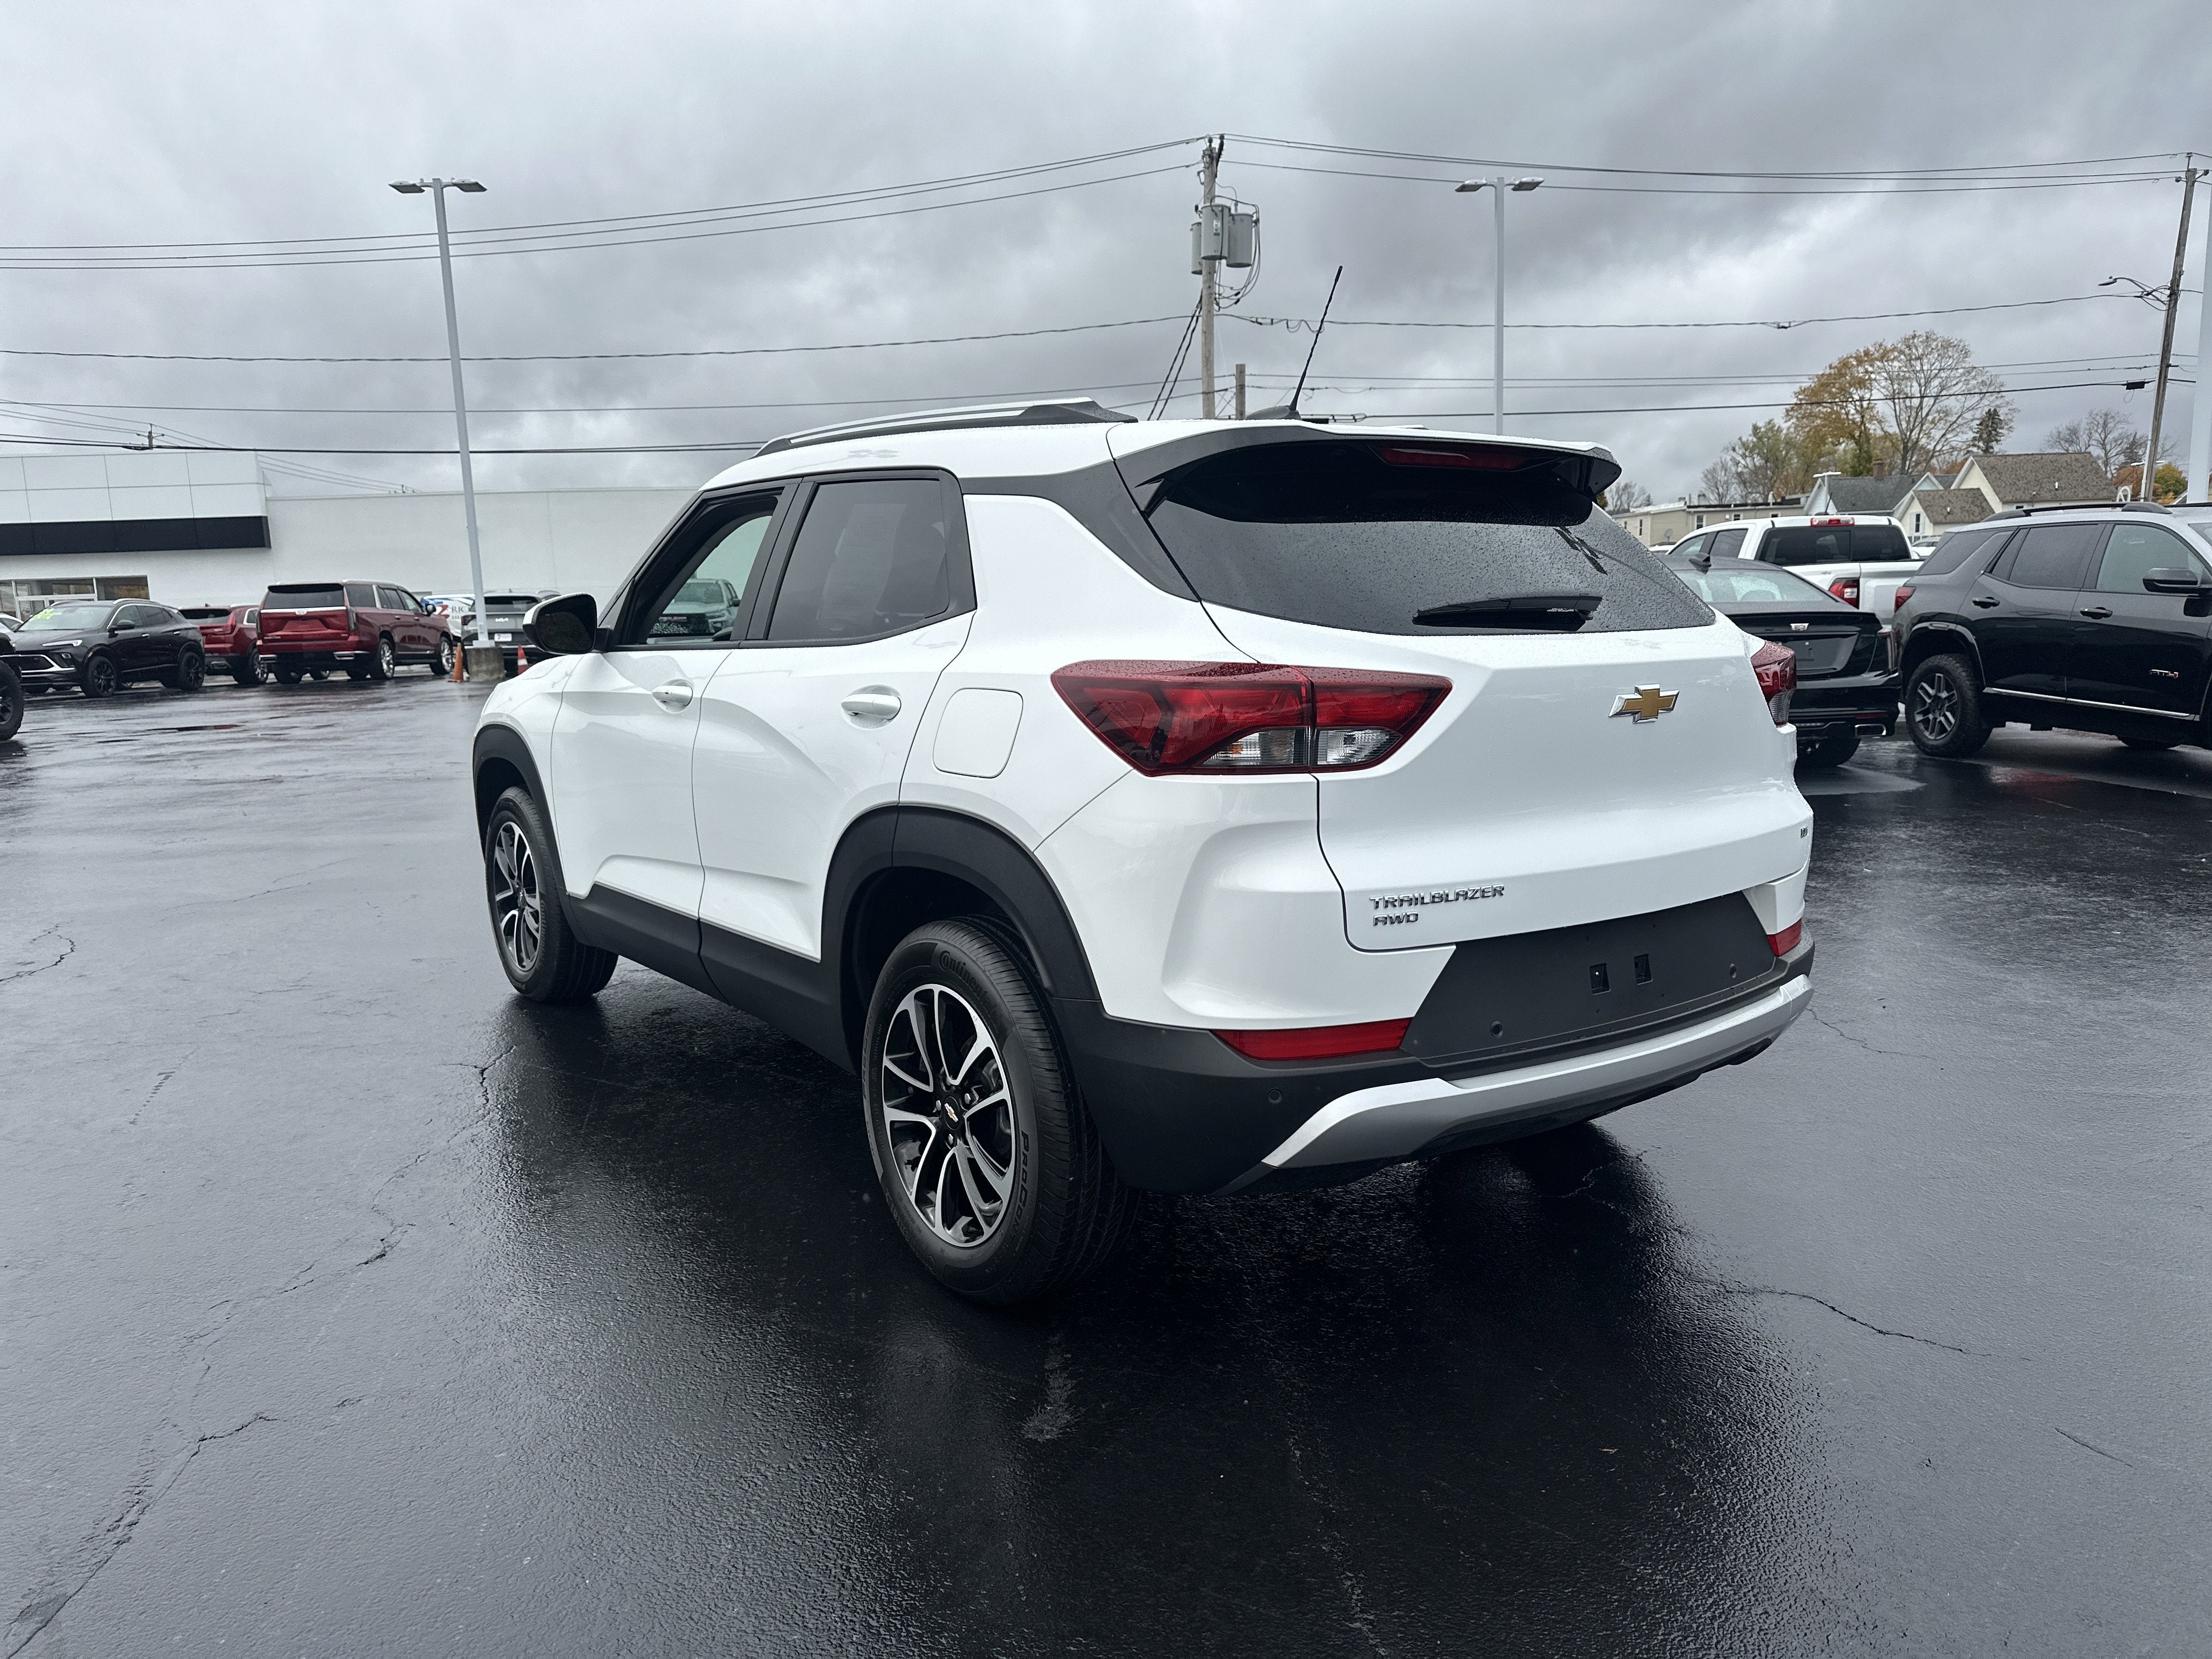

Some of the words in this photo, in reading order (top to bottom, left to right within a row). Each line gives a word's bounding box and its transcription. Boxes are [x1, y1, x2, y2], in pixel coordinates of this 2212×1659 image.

[1370, 884, 1505, 909] TRAILBLAZER
[1373, 911, 1419, 926] AWD
[939, 949, 998, 1013] Continental
